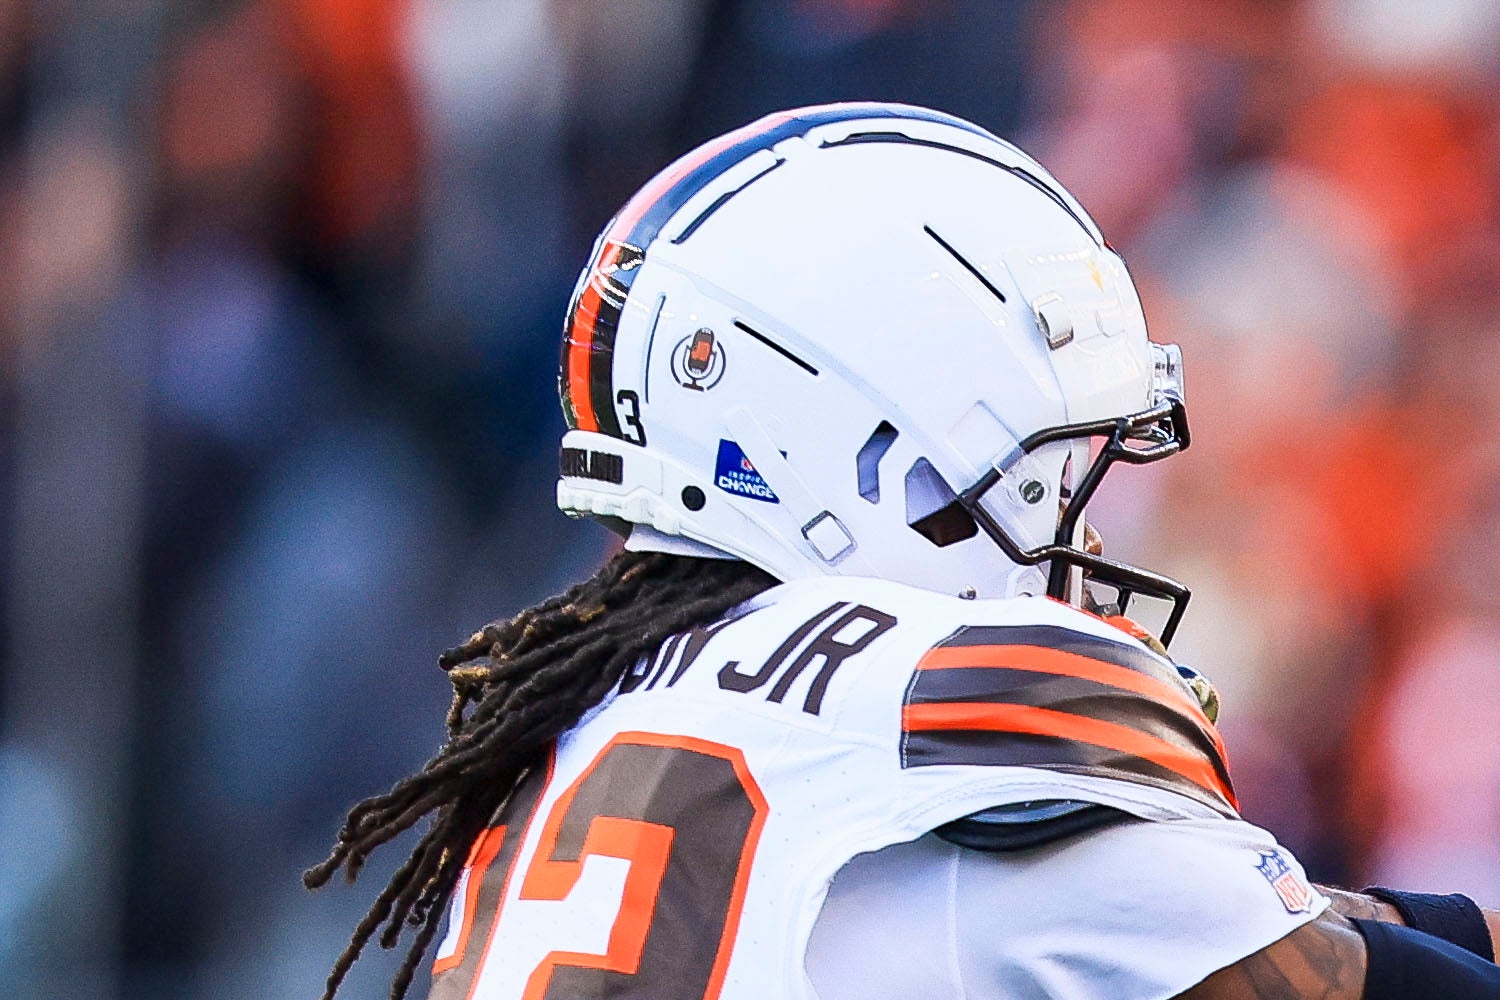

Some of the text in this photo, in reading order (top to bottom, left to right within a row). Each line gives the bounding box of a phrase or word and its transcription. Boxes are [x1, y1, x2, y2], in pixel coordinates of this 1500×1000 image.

[617, 389, 647, 448] 3
[718, 475, 775, 499] CHANGE
[717, 601, 898, 716] JR
